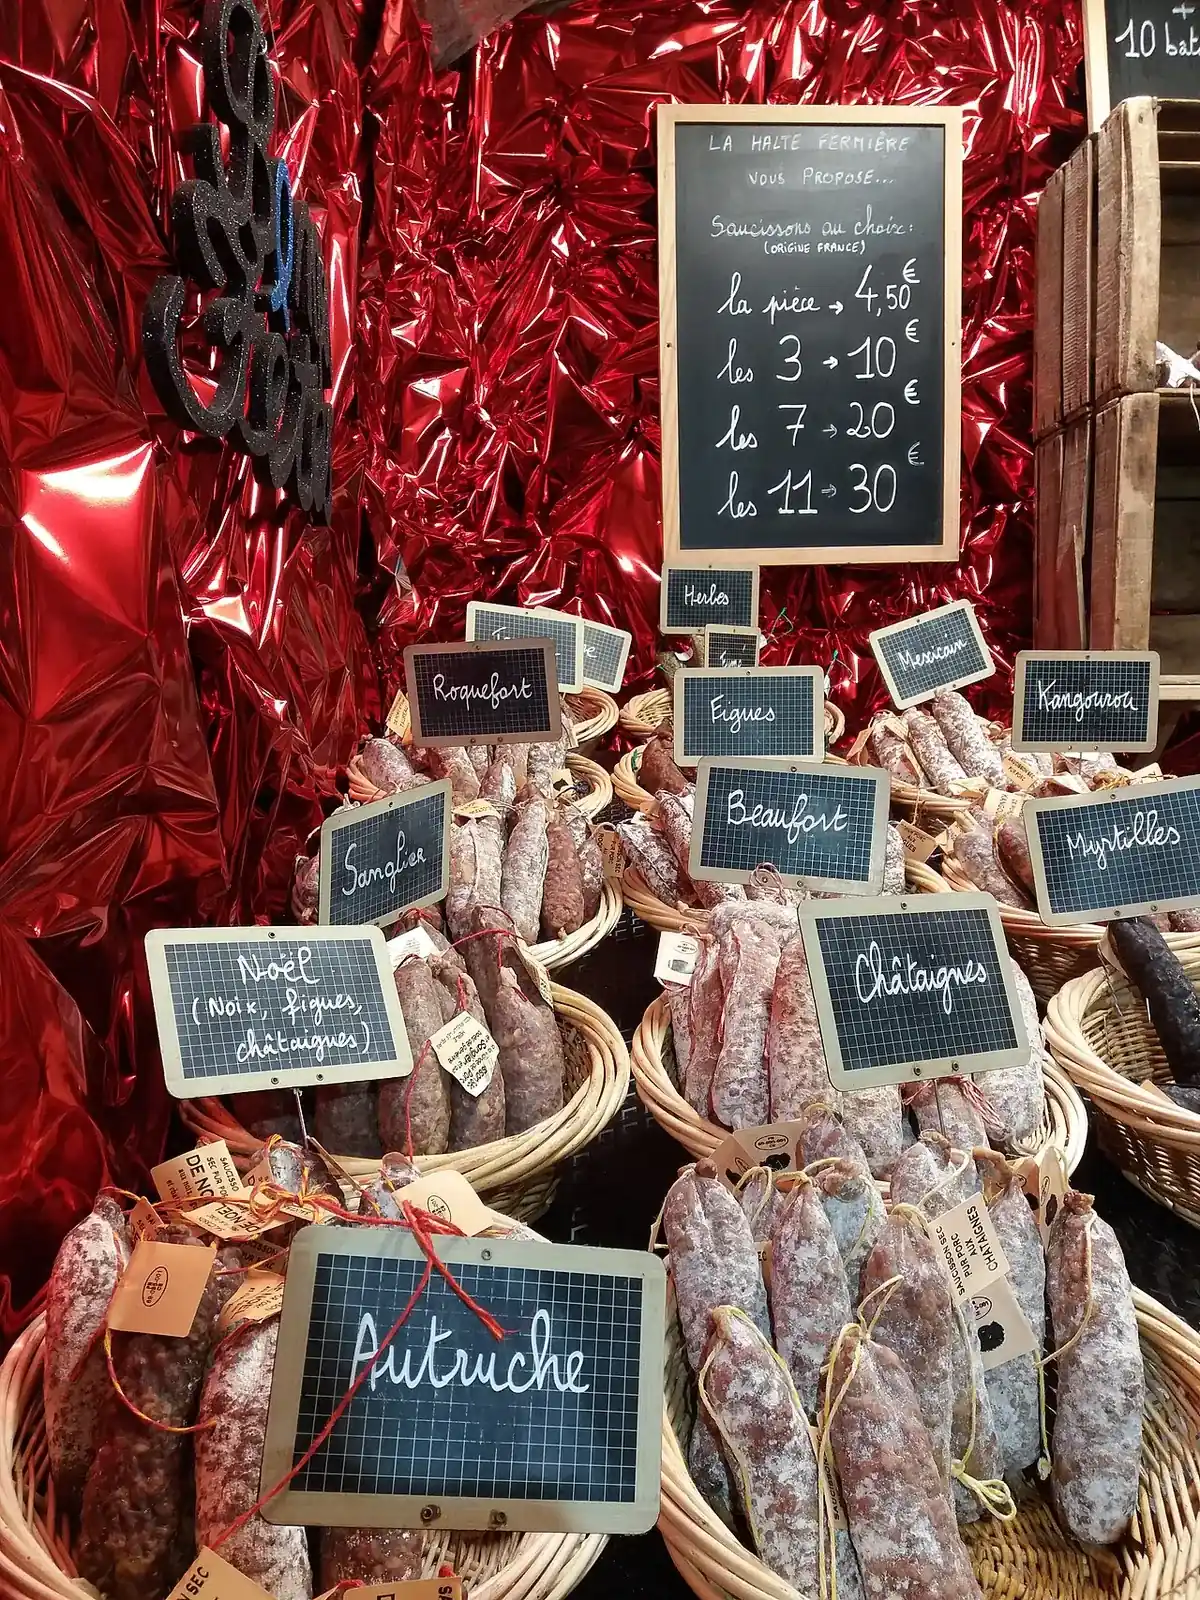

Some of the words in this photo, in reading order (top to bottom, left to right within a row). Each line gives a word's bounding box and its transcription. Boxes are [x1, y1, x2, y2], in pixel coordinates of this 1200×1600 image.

[1115, 18, 1156, 57] 10
[1165, 21, 1200, 56] bât
[708, 134, 733, 153] LA
[751, 133, 801, 152] HALTE
[819, 131, 911, 153] FERMIÈRE
[749, 171, 785, 186] VOUS
[710, 214, 811, 238] Saucissons
[822, 222, 846, 236] au
[817, 239, 866, 255] FRANCE)
[717, 271, 752, 316] la
[762, 286, 821, 325] pièce
[717, 338, 754, 384] les
[776, 334, 802, 382] 3
[847, 336, 897, 379] 10
[715, 404, 758, 451] les
[778, 404, 807, 446] 7
[846, 401, 895, 439] 20
[717, 470, 758, 519] les
[767, 469, 818, 515] 11
[849, 463, 897, 514] 30
[684, 583, 730, 606] Herbes
[897, 633, 969, 672] Mexicain
[433, 672, 533, 711] Roquefort
[1037, 679, 1139, 722] Kangourou
[710, 694, 777, 734] Figues
[727, 788, 848, 845] Beaufort
[1066, 810, 1181, 870] Myrtilles
[237, 946, 320, 985] Noël
[855, 940, 987, 1015] Châtaignes
[282, 988, 363, 1026] figues,
[186, 1155, 205, 1177] DE
[206, 1156, 217, 1170] SEC
[213, 1170, 222, 1184] PUR
[220, 1157, 239, 1192] SAUCISSO
[215, 1202, 244, 1226] NOEL
[936, 1225, 947, 1246] SEC
[951, 1232, 966, 1258] PORC
[965, 1237, 978, 1257] AUX
[967, 1205, 998, 1272] CHATAIGNES
[757, 1251, 767, 1261] EC
[943, 1245, 966, 1296] SAUCISSON
[960, 1257, 973, 1278] PUR
[349, 1308, 590, 1393] Autruche
[186, 1566, 209, 1595] SEC
